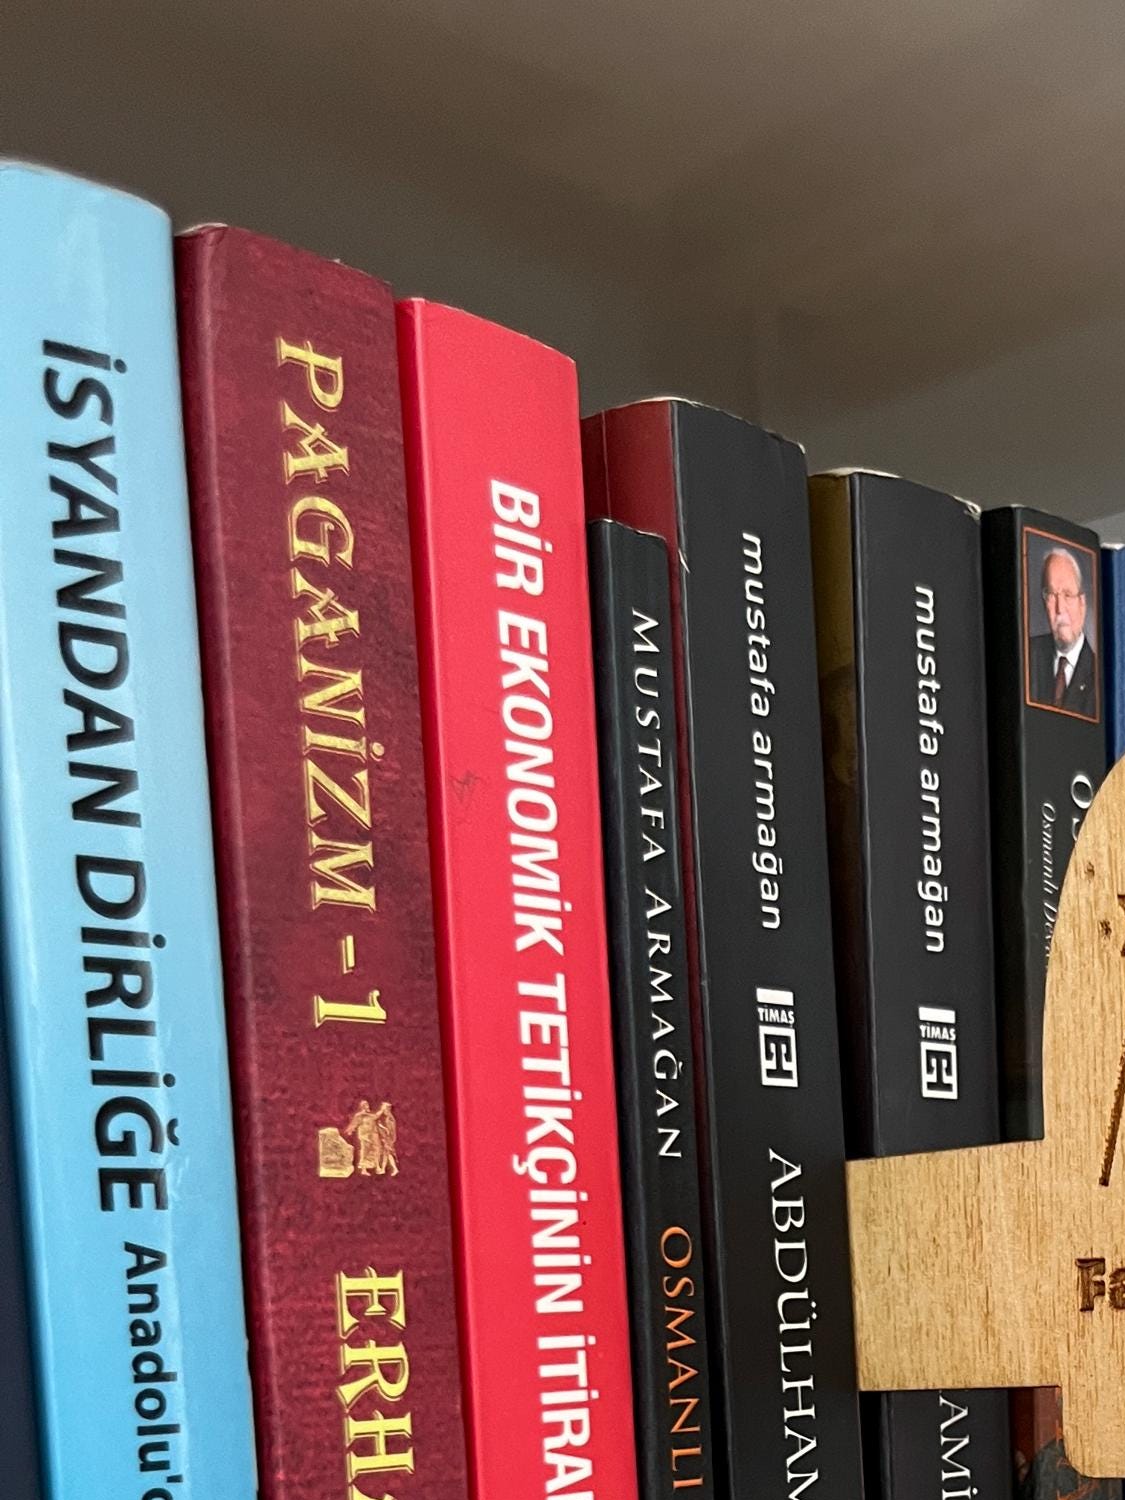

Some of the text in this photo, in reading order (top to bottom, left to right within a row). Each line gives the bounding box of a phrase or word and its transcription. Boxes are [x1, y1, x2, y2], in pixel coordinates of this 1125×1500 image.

[42, 338, 142, 829] İSYANDAN
[276, 336, 384, 915] PAGANİZM
[489, 479, 554, 597] BİR
[498, 608, 572, 954] EKONOMİK
[631, 606, 666, 864] MUSTAFA
[742, 532, 784, 931] mustafa armağan
[914, 585, 946, 955] mustafa armağan
[76, 855, 180, 1213] DİRLİĞE
[511, 973, 590, 1315] TETİKÇİNİN
[645, 889, 683, 1160] ARMAĞAN
[660, 1226, 704, 1491] OSMANLI
